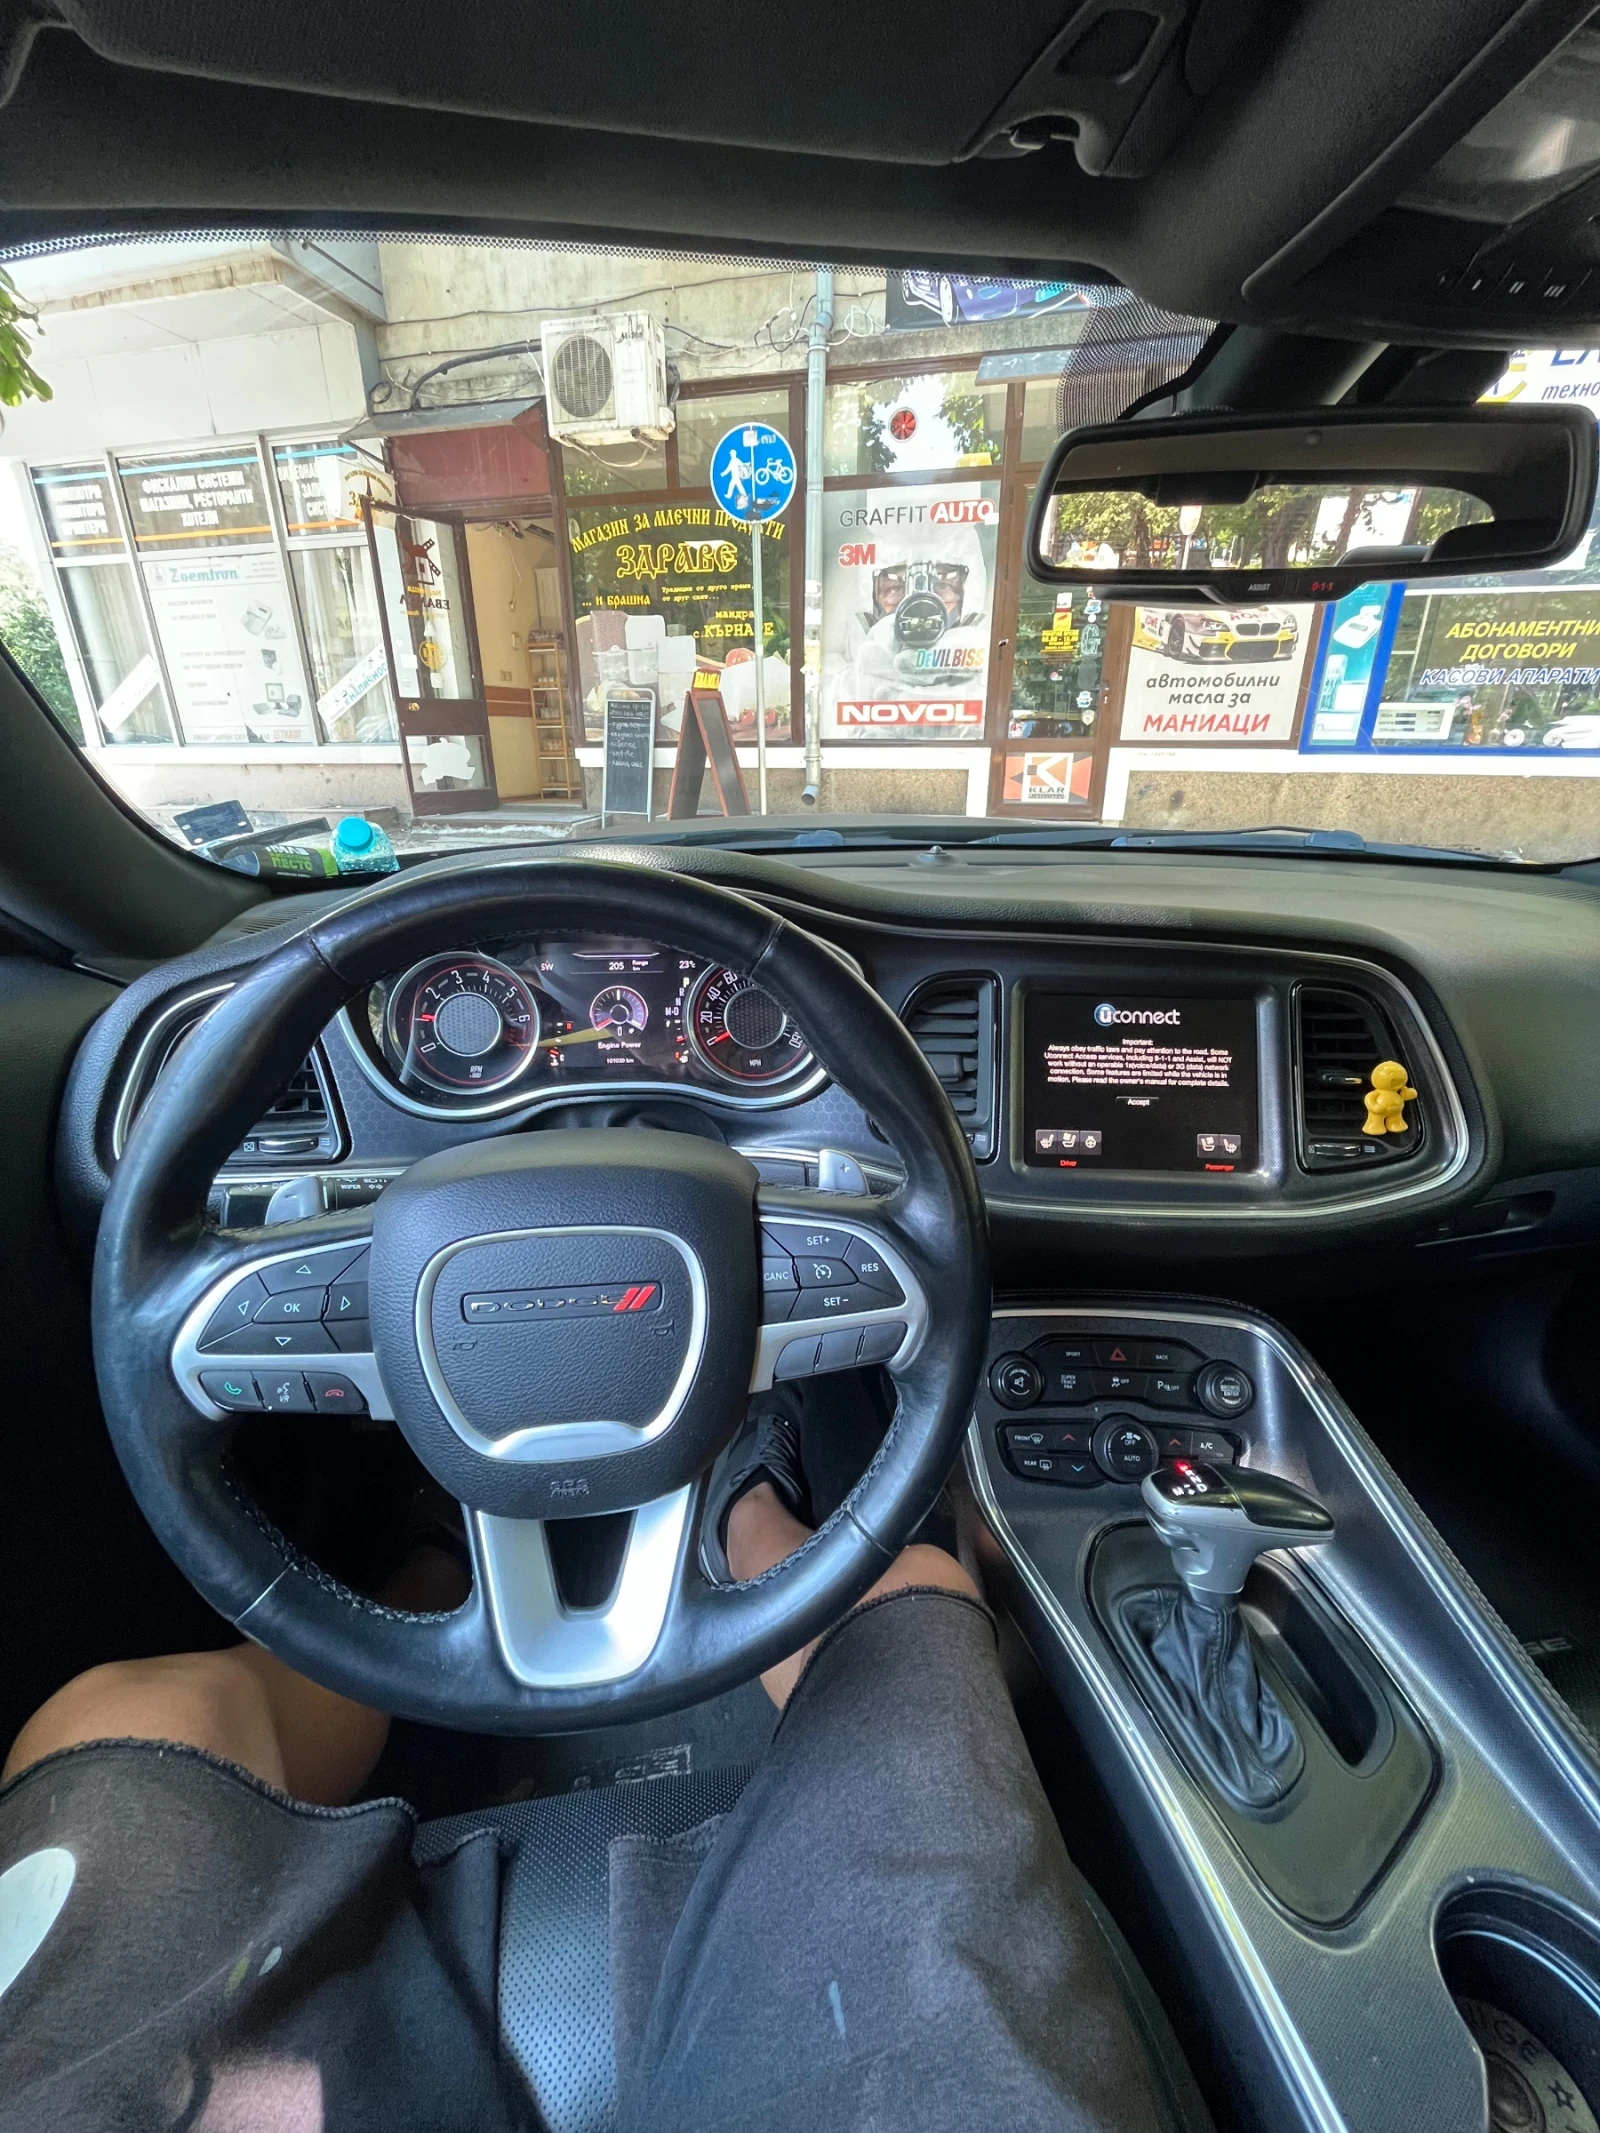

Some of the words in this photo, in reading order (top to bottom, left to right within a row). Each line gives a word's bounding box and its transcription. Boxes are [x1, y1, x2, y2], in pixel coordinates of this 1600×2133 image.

[142, 474, 197, 494] ФИСКАЛНИ
[199, 470, 245, 489] СИСТЕМИ
[194, 489, 254, 508] РЕСТОРАНТИ
[840, 506, 927, 527] GRAFFIT
[932, 500, 996, 523] AUTO
[571, 518, 629, 553] МАГАЗИН
[633, 513, 651, 532] ЗА
[653, 508, 710, 527] МЛЕЧНИ
[616, 541, 738, 580] ЗДРАВЕ
[838, 543, 876, 567] 3M
[1248, 583, 1271, 591] ASSIST
[1445, 619, 1600, 639] АБОНАМЕНТНИ
[1459, 642, 1577, 662] ДОГОВОРИ
[1146, 672, 1280, 689] автомобилни
[1419, 667, 1504, 685] КАСОВИ
[1506, 666, 1600, 685] АПАРАТИ
[1168, 692, 1225, 705] масла
[1227, 692, 1251, 708] за
[842, 703, 977, 723] NOVOL
[1143, 713, 1271, 736] МАНИАЦИ
[1029, 786, 1065, 794] KLAR
[609, 961, 625, 971] 205
[451, 970, 463, 985] 3
[482, 970, 490, 984] 4
[683, 977, 690, 988] P
[425, 986, 441, 1000] 2
[506, 985, 518, 998] 5
[679, 988, 685, 997] R
[707, 986, 721, 1003] 40
[518, 1014, 530, 1023] 6
[700, 1011, 713, 1025] 20
[421, 1042, 437, 1053] 0
[598, 1041, 620, 1050] Engine
[621, 1041, 642, 1049] Power
[1127, 1098, 1150, 1107] Accept
[861, 1263, 879, 1273] RES
[764, 1271, 789, 1281] CANC
[284, 1302, 300, 1313] OK
[470, 1291, 624, 1314] DODGE
[1200, 1441, 1214, 1450] A/C
[1124, 1454, 1141, 1462] AUTO
